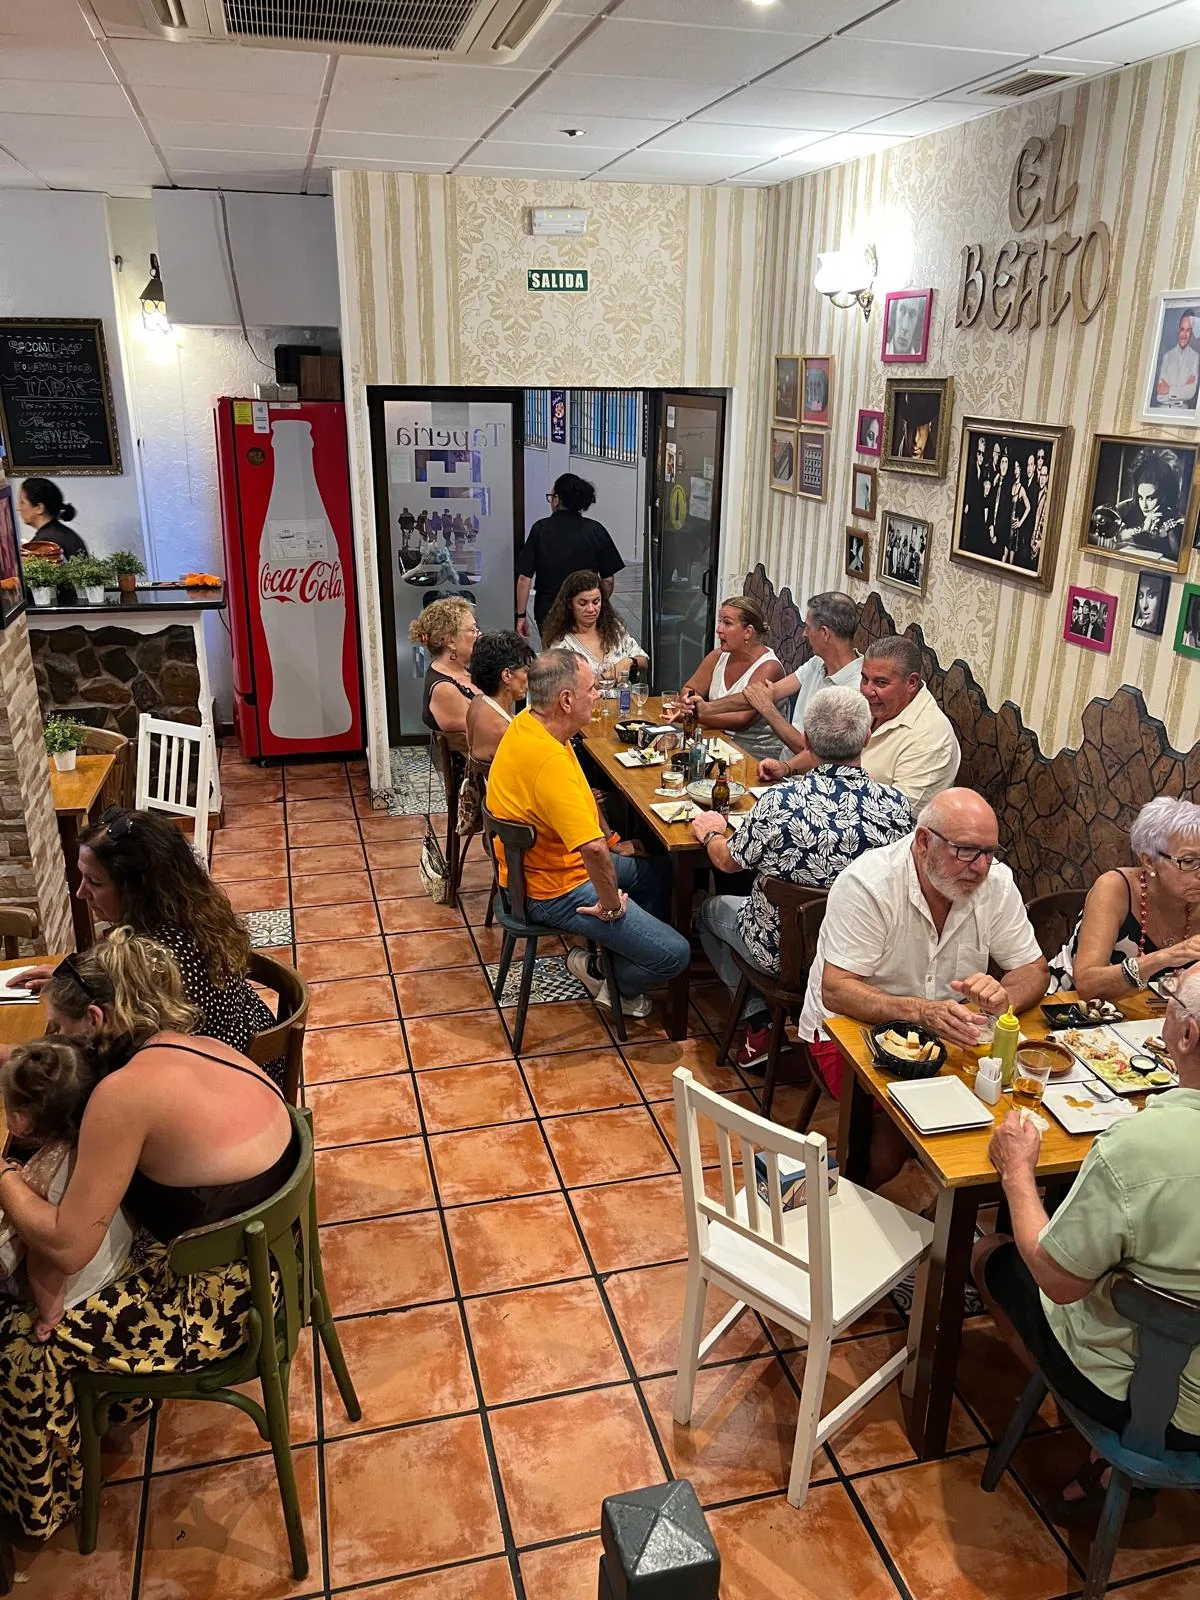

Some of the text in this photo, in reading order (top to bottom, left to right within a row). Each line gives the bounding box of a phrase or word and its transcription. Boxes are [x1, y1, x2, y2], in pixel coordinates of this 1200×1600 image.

[1009, 124, 1078, 232] EL
[531, 272, 584, 288] SALIDA
[24, 381, 87, 396] TAPAS
[260, 560, 344, 604] Coca-Cola
